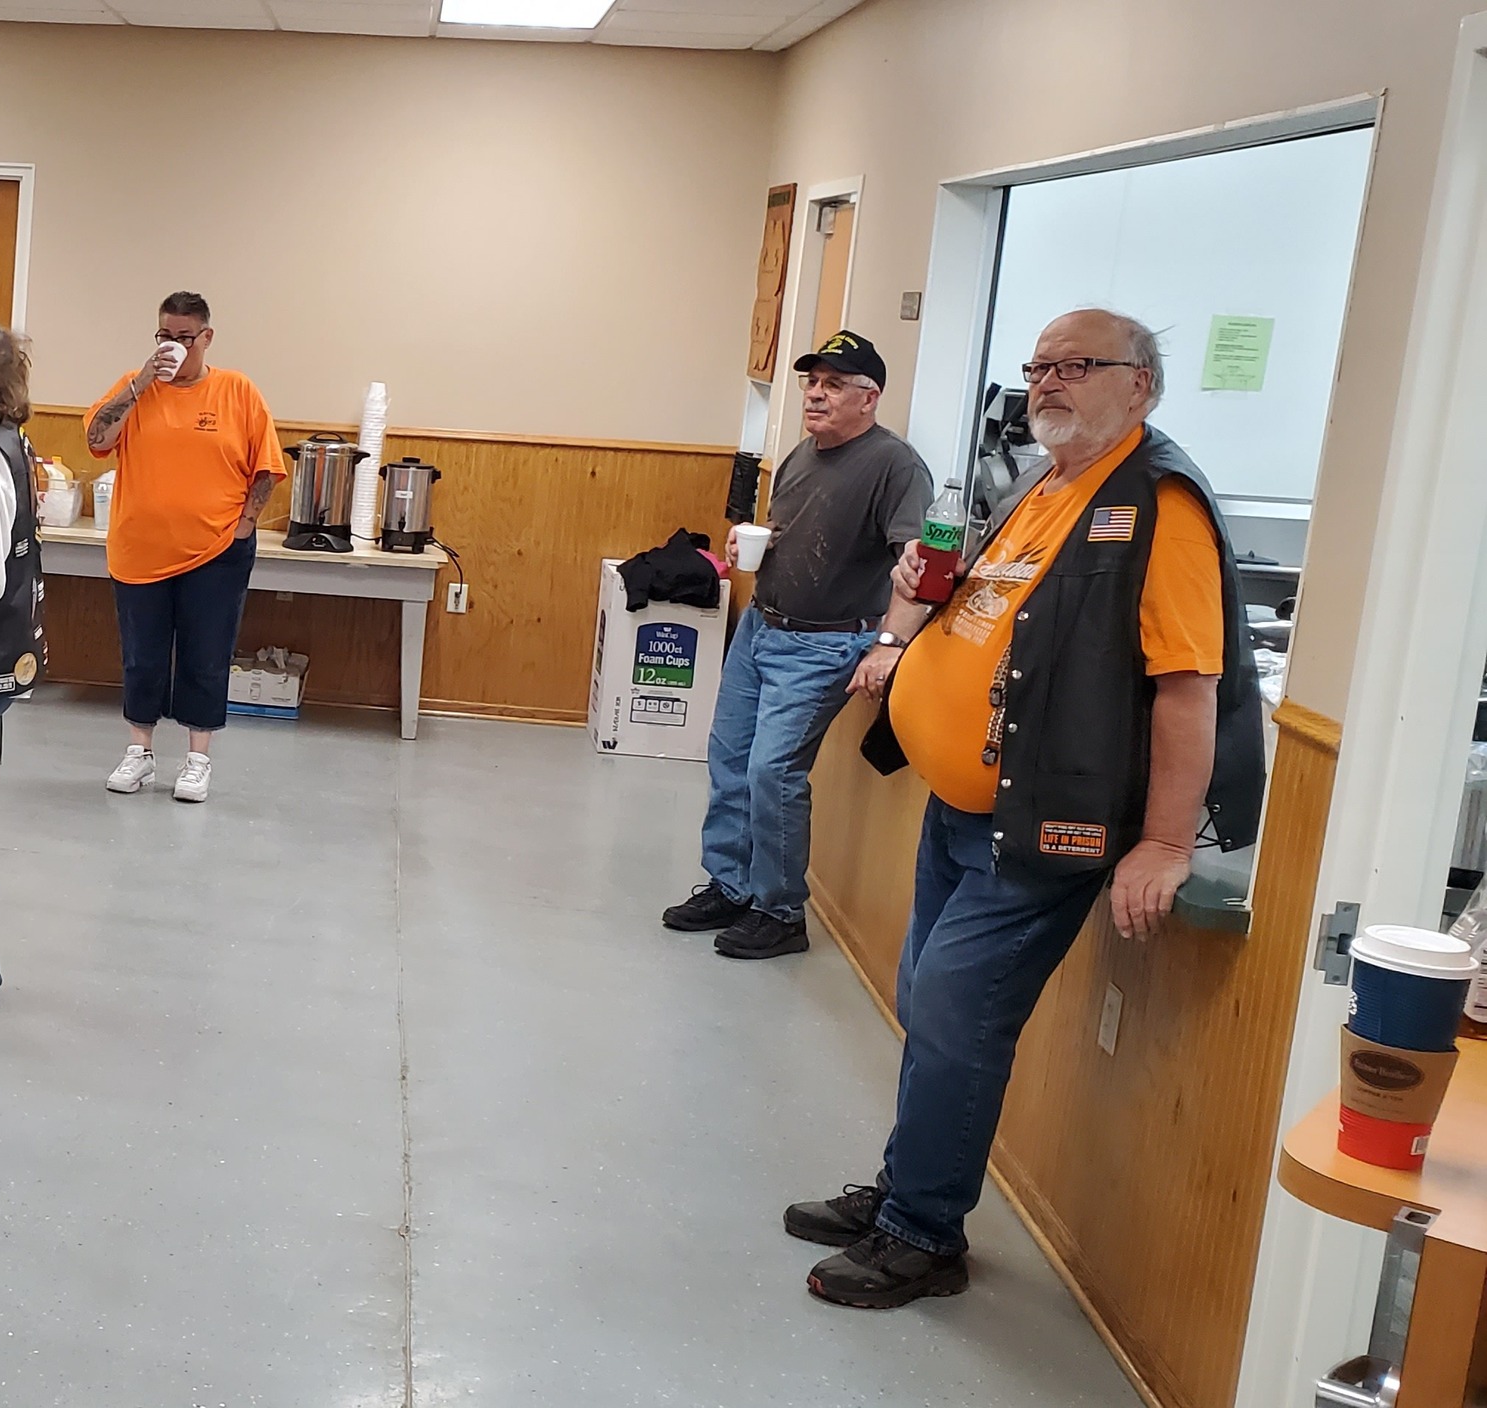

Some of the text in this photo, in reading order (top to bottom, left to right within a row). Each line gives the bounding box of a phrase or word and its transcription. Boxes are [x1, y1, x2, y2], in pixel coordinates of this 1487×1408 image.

[648, 641, 682, 653] 1000ct
[638, 653, 690, 668] Foam Cups
[1044, 834, 1058, 844] LIFE
[1072, 836, 1101, 847] PRISON
